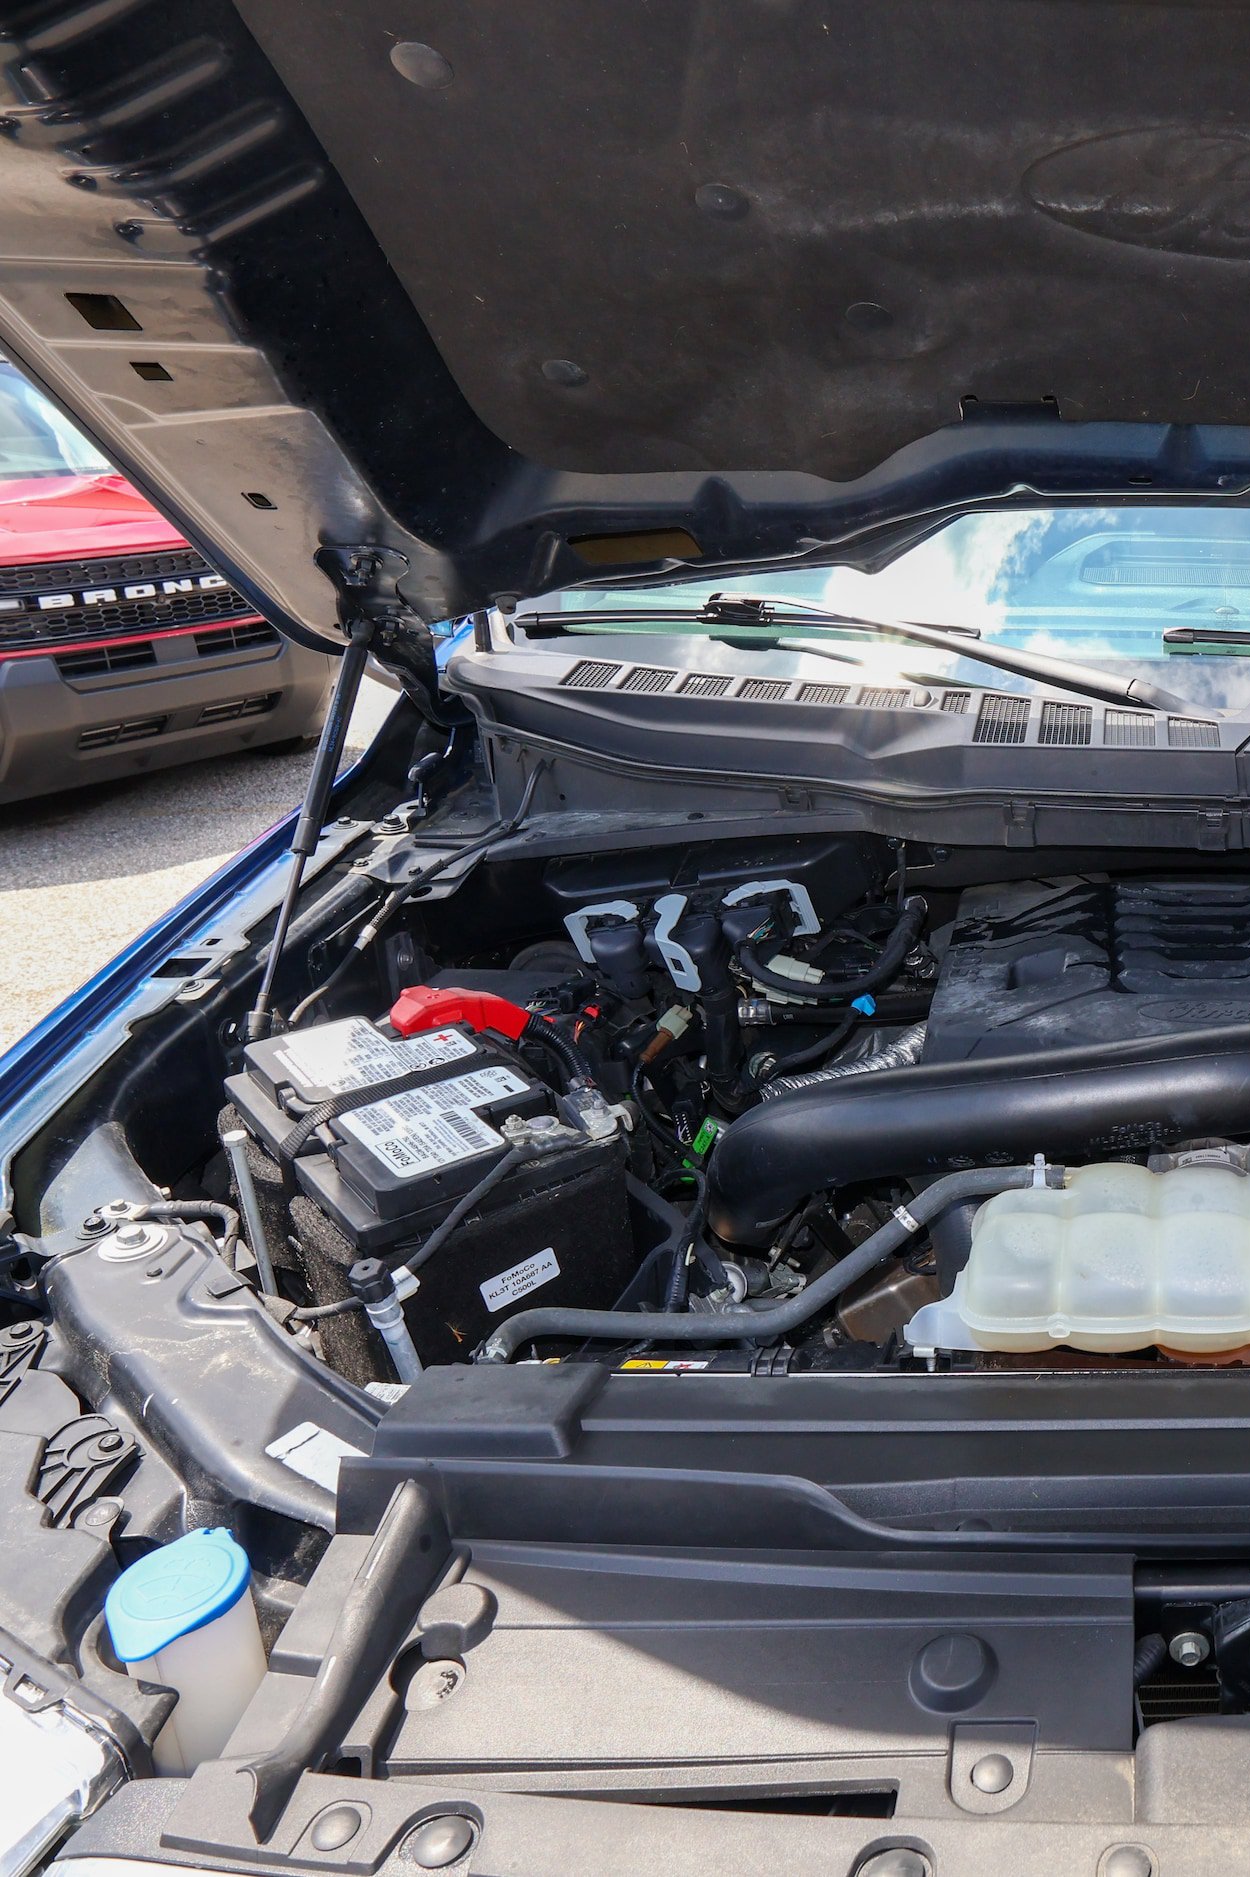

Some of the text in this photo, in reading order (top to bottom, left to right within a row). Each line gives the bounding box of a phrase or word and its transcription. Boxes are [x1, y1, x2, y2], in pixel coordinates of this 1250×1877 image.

[38, 575, 228, 610] BRONC
[385, 1141, 415, 1167] FoMoCo
[489, 1285, 510, 1300] KL3T
[541, 1261, 553, 1272] AA
[501, 1263, 535, 1284] FoMoCo
[512, 1280, 537, 1297] C500L
